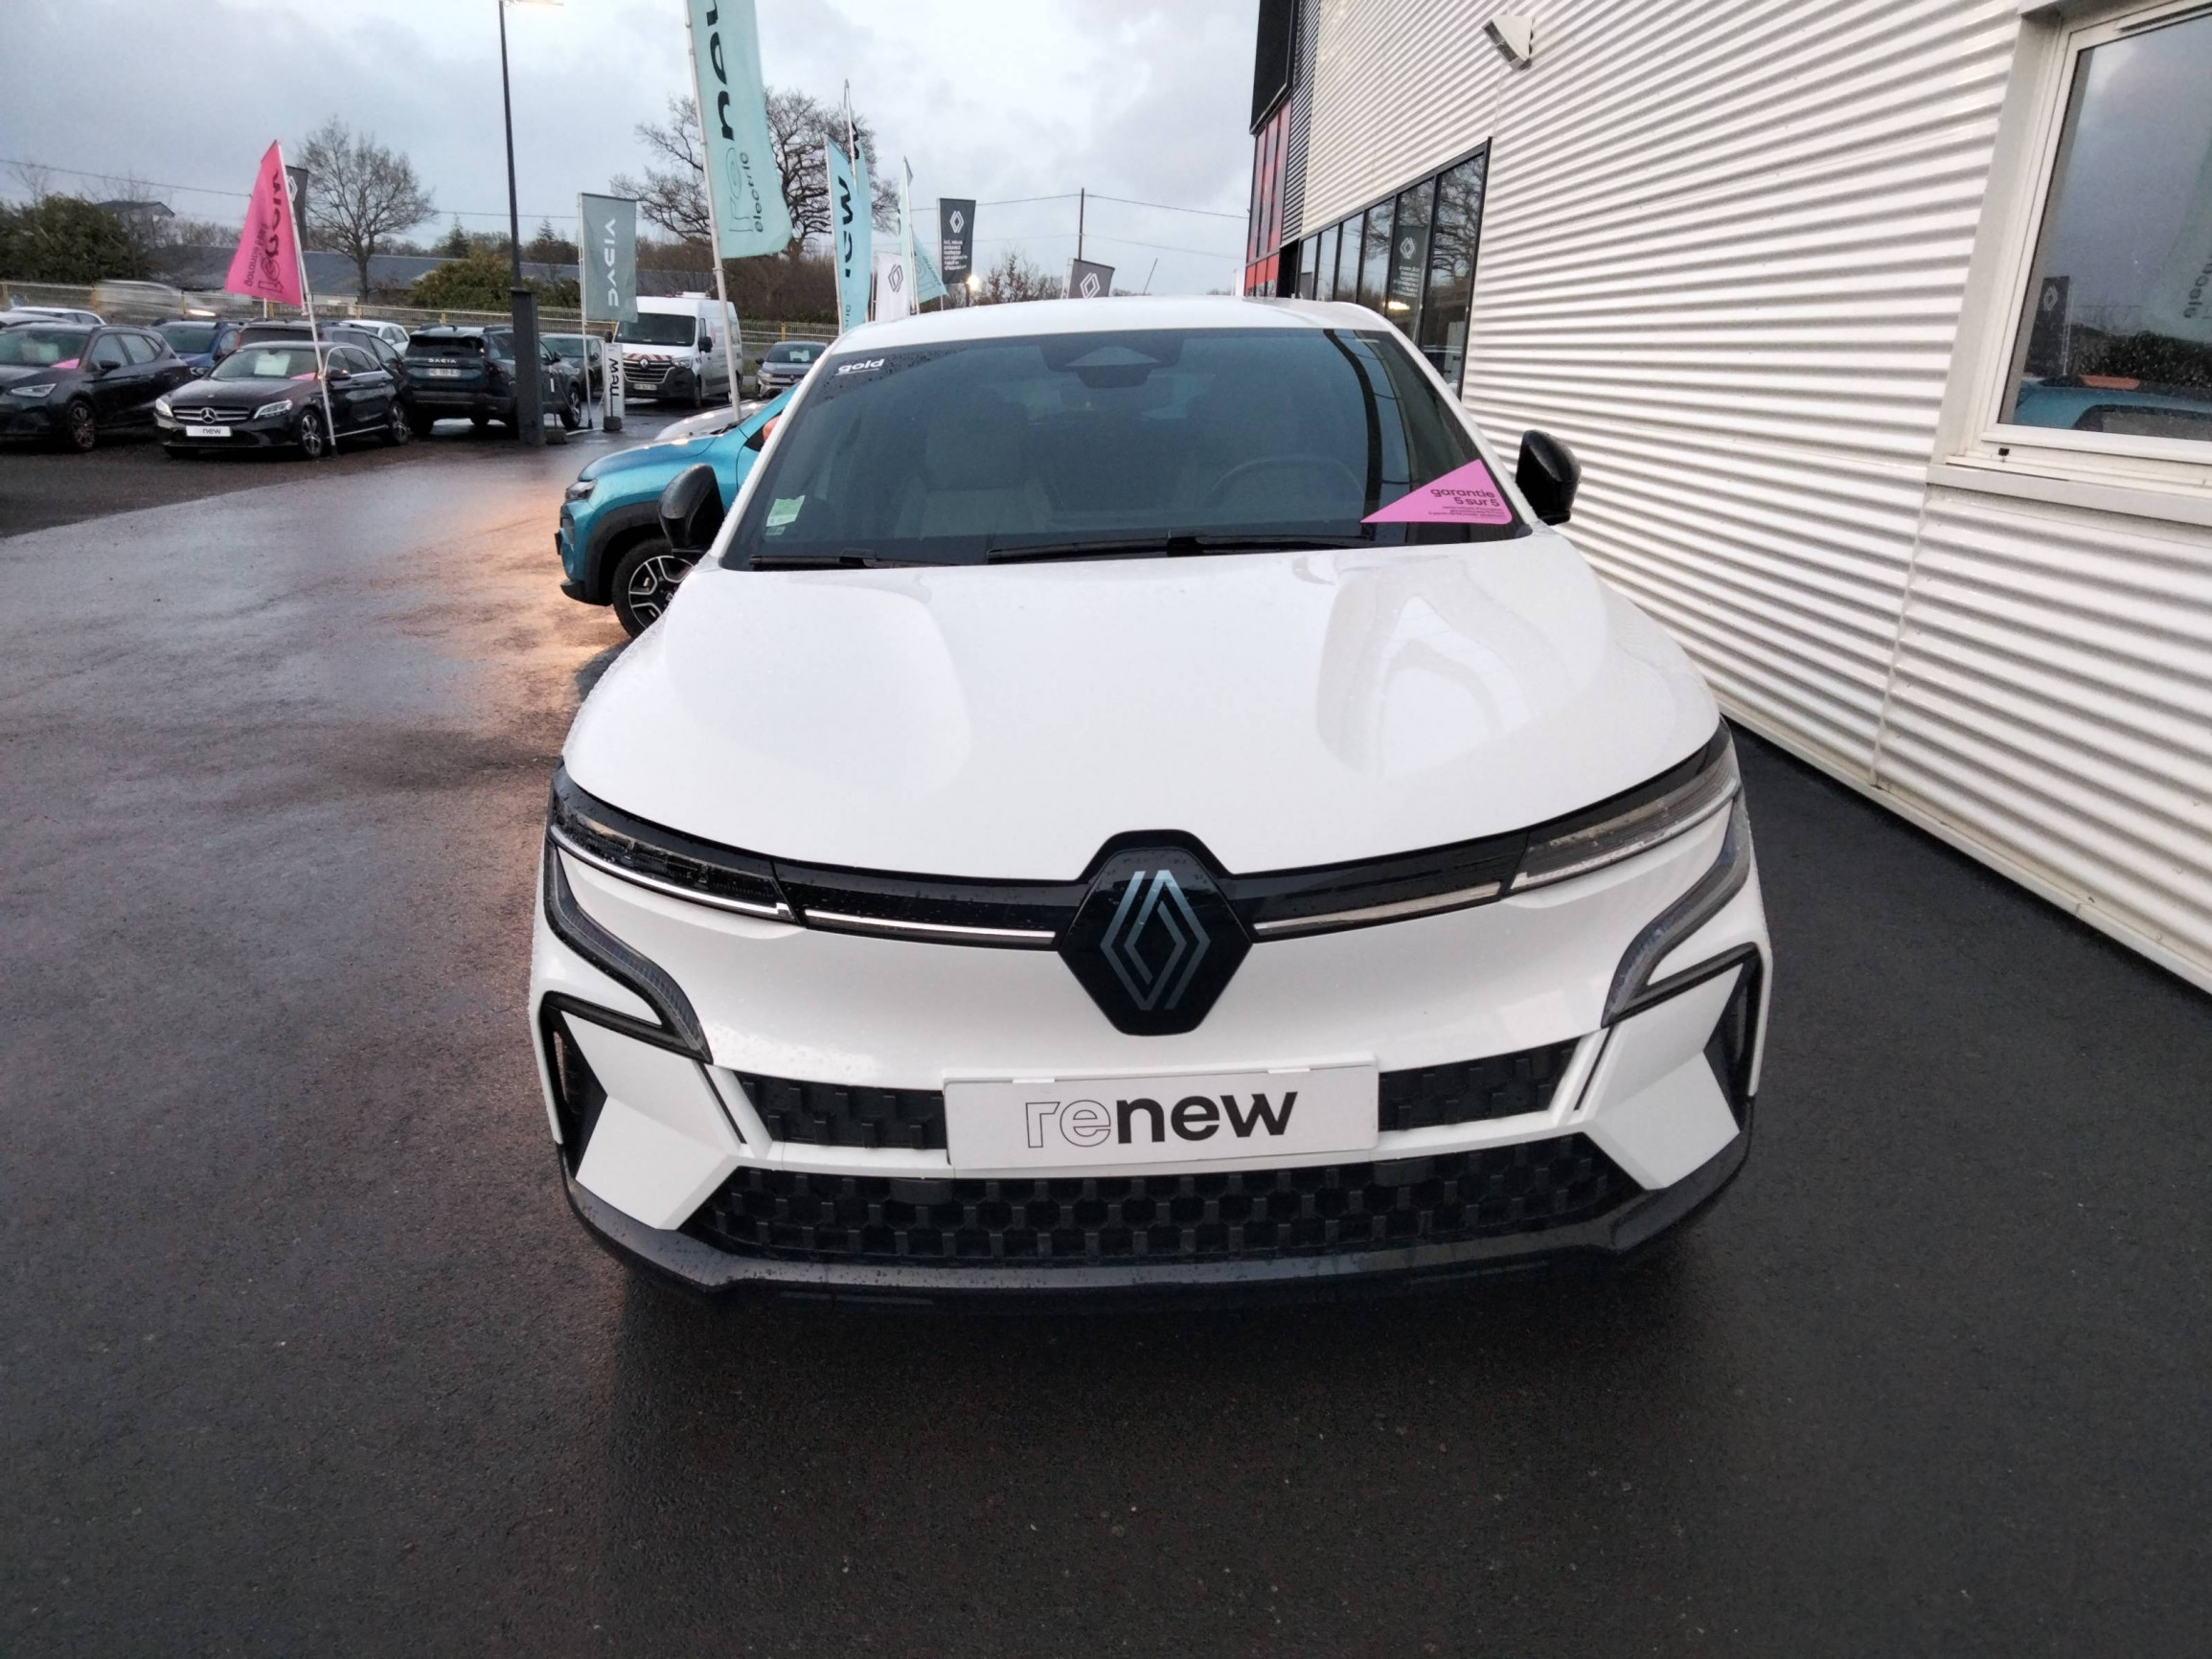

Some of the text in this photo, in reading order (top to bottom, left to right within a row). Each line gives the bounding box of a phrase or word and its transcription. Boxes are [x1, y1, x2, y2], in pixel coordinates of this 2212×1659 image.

[740, 152, 763, 232] electric
[604, 217, 619, 307] DACIA
[838, 358, 885, 374] gold
[1430, 489, 1495, 499] garantie
[1491, 498, 1500, 507] 5
[1025, 1091, 1298, 1148] renew
